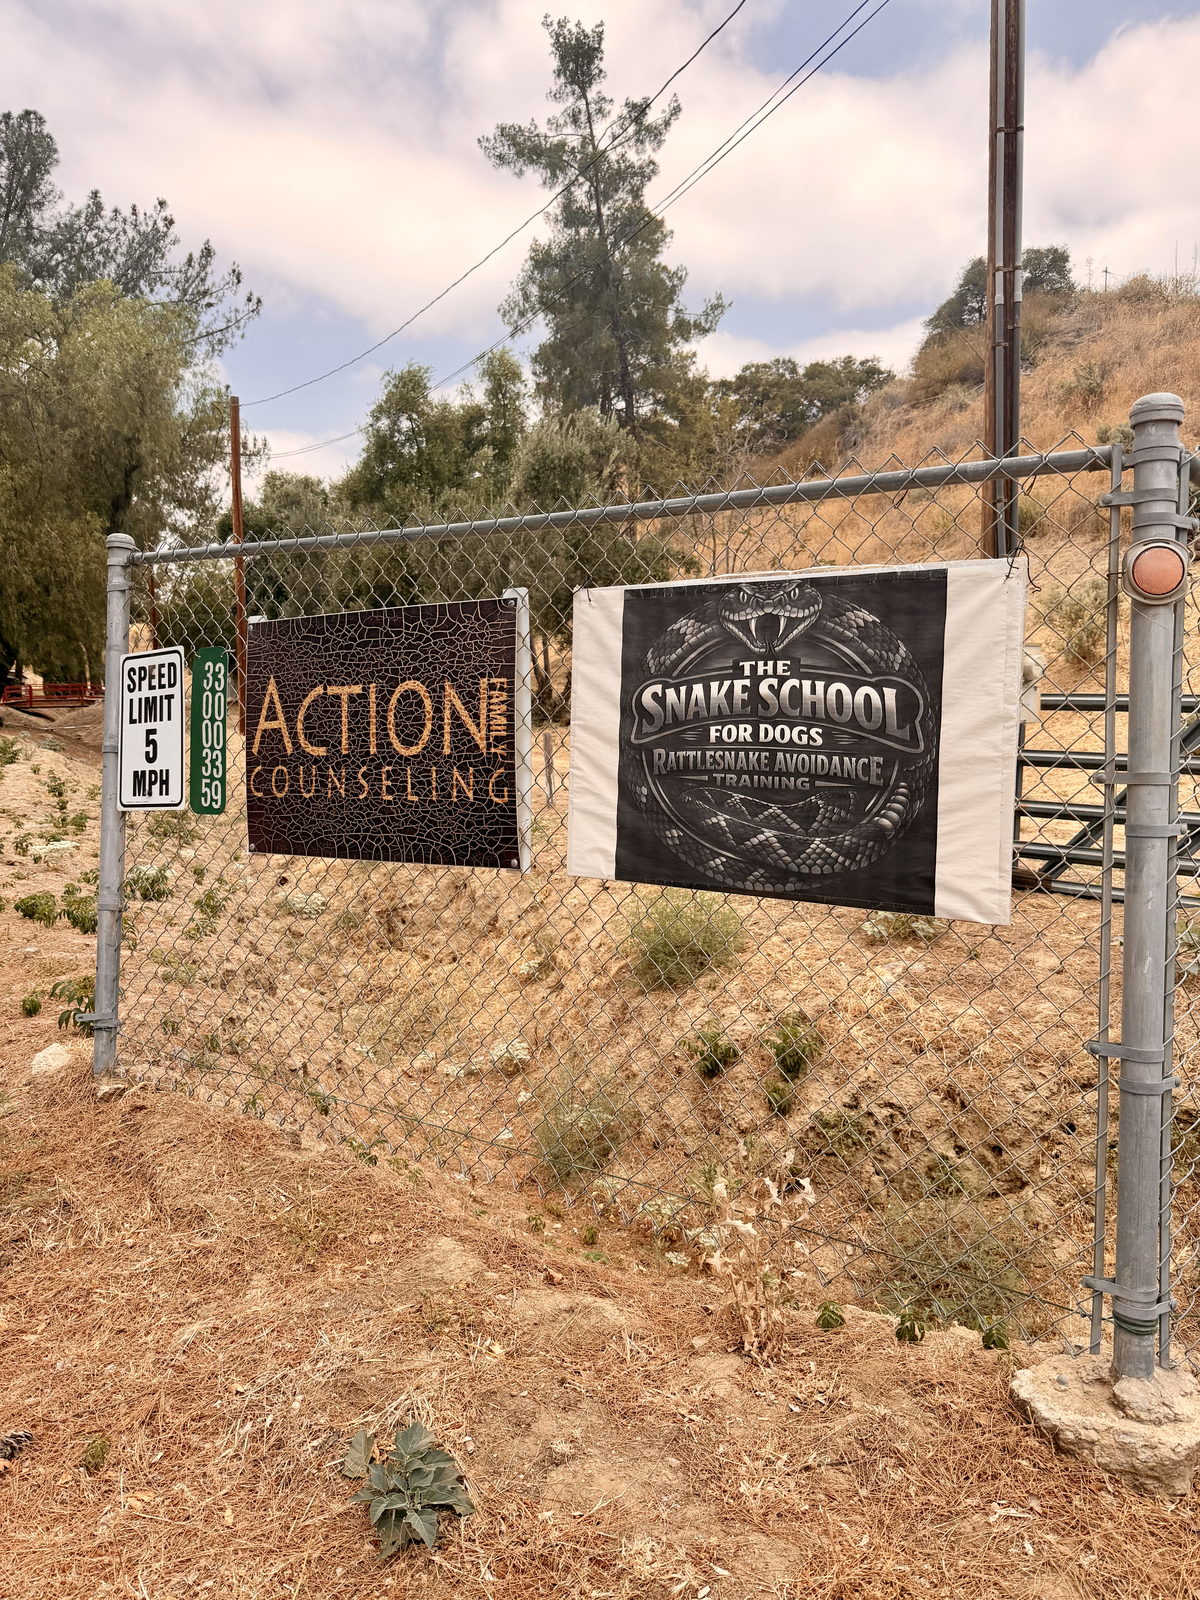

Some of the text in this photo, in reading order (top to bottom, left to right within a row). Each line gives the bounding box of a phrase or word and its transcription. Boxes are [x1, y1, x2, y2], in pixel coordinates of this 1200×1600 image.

[127, 662, 177, 693] SPEED
[739, 660, 791, 677] THE
[129, 694, 174, 725] LIMIT
[252, 675, 488, 756] ACTION
[489, 678, 508, 756] FAMILY
[641, 678, 910, 741] SNAKE SCHOOL
[145, 728, 158, 764] 5
[708, 724, 823, 746] FOR DOGS
[132, 769, 170, 797] MPH
[652, 748, 884, 786] RATTLESNAKE AVOIDANCE
[713, 774, 810, 791] TRAINING
[250, 765, 508, 803] COUNSELING
